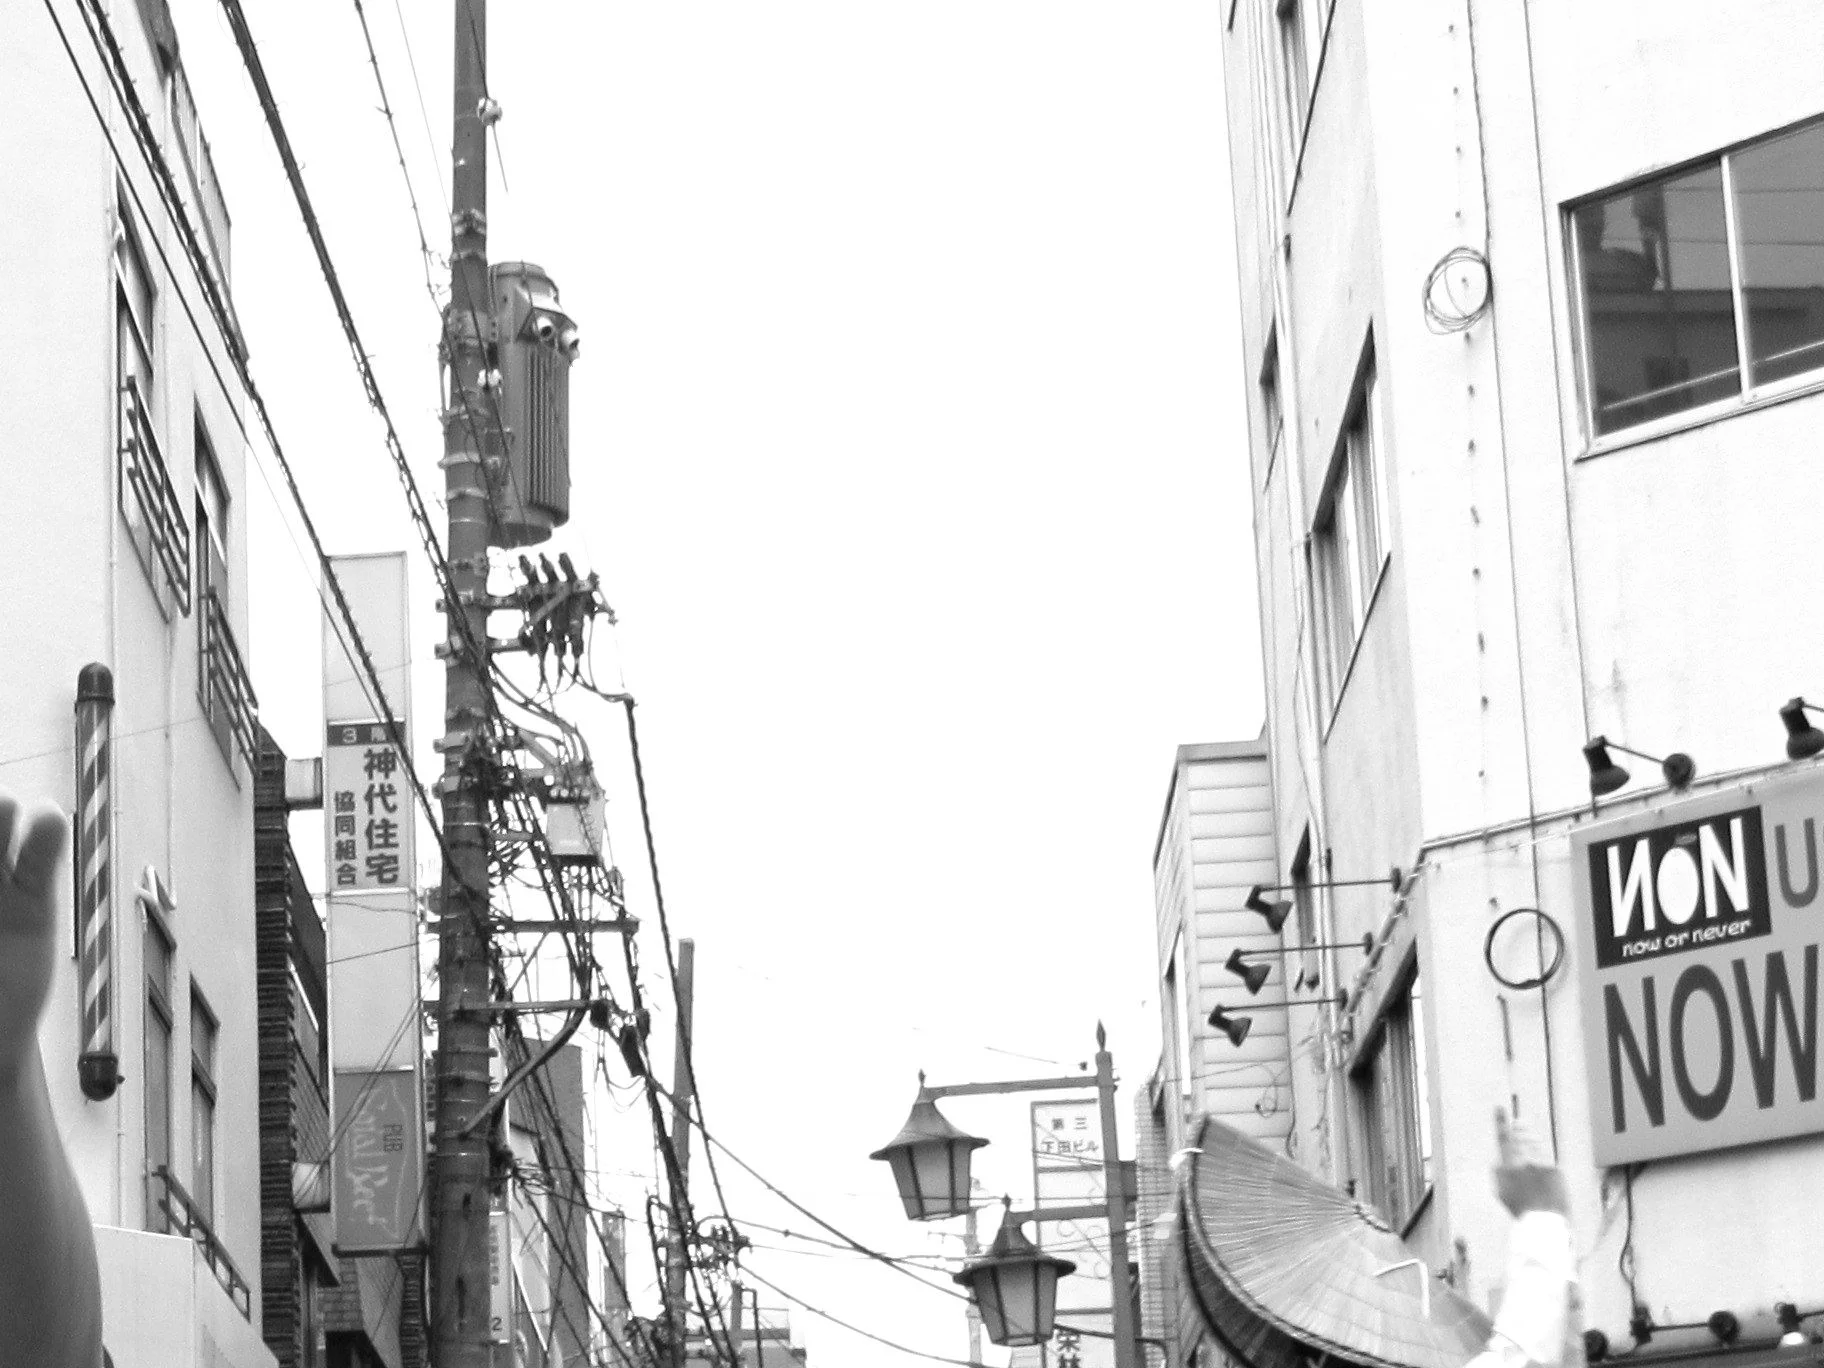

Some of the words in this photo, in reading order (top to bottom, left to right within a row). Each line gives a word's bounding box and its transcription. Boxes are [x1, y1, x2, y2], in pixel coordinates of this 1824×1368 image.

[363, 748, 399, 884] 神代住宅
[1621, 933, 1661, 957] now
[1664, 930, 1690, 949] or
[1692, 918, 1752, 945] never
[1603, 944, 1821, 1135] NOW
